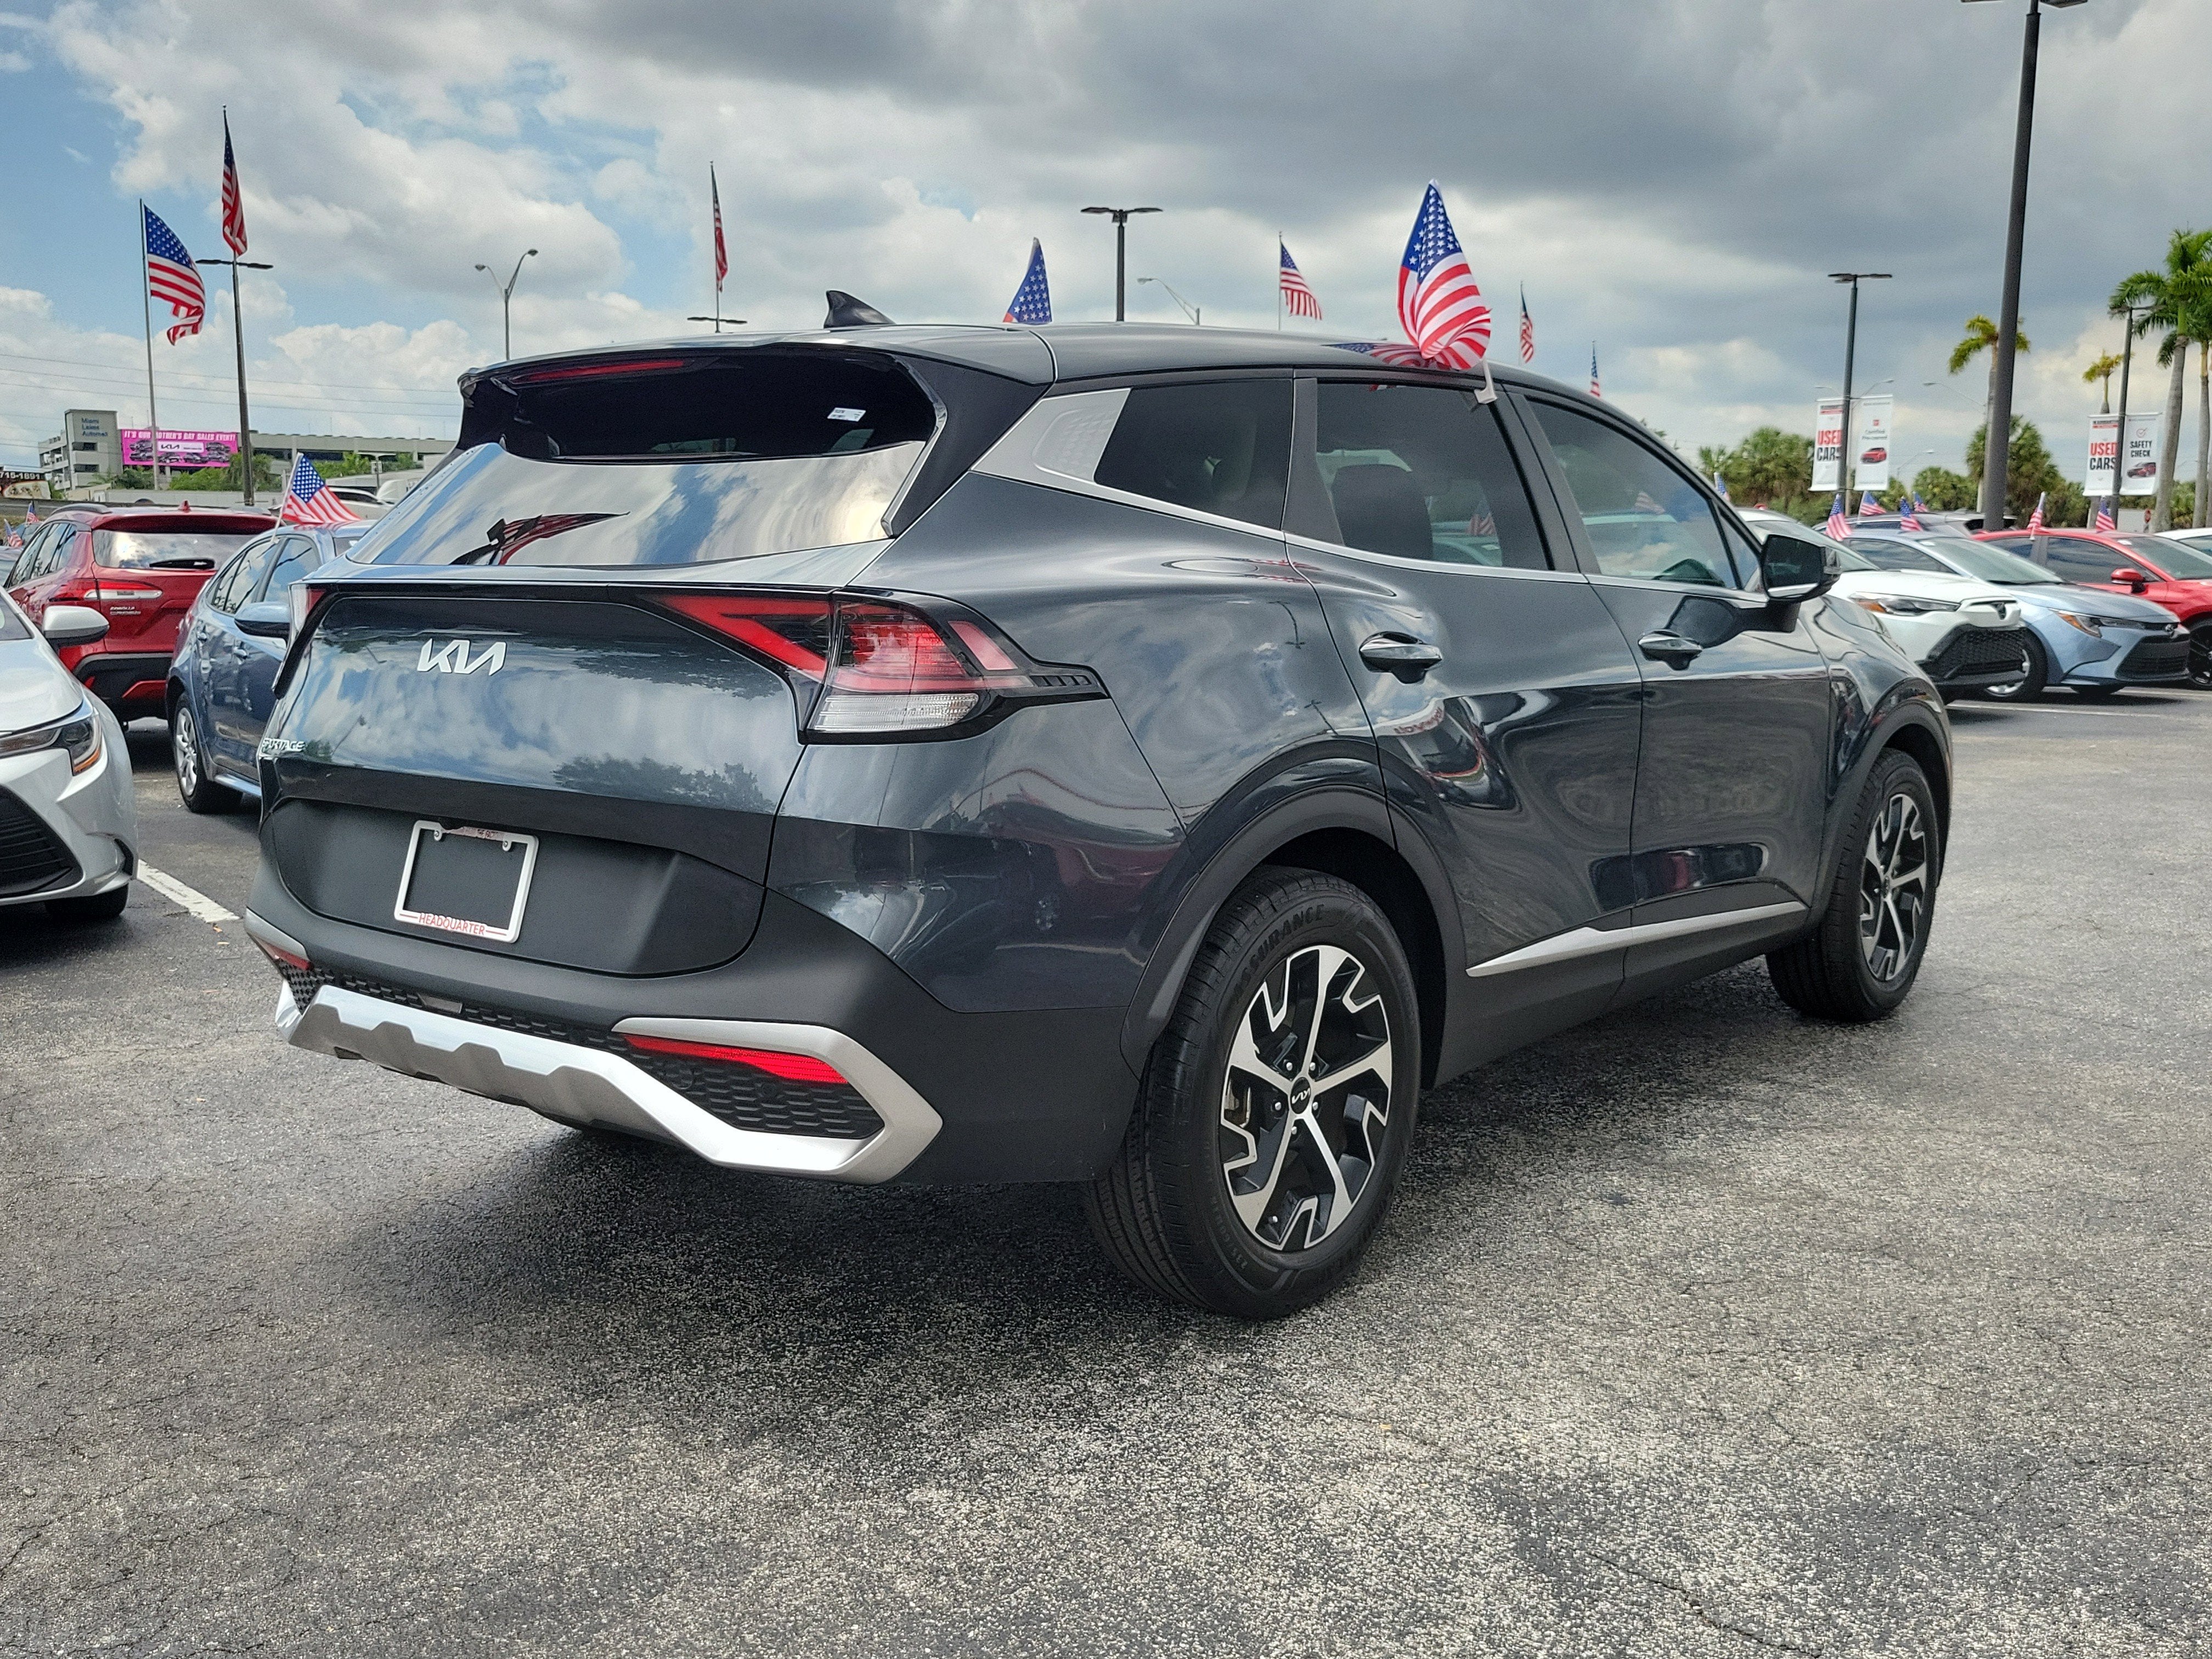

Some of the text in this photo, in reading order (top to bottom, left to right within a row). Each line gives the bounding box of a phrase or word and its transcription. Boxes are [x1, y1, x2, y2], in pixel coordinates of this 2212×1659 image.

[2130, 440, 2152, 449] SAFETY
[2130, 449, 2151, 458] CHECK
[417, 638, 507, 676] KIA
[419, 912, 486, 936] HEADQUARTER
